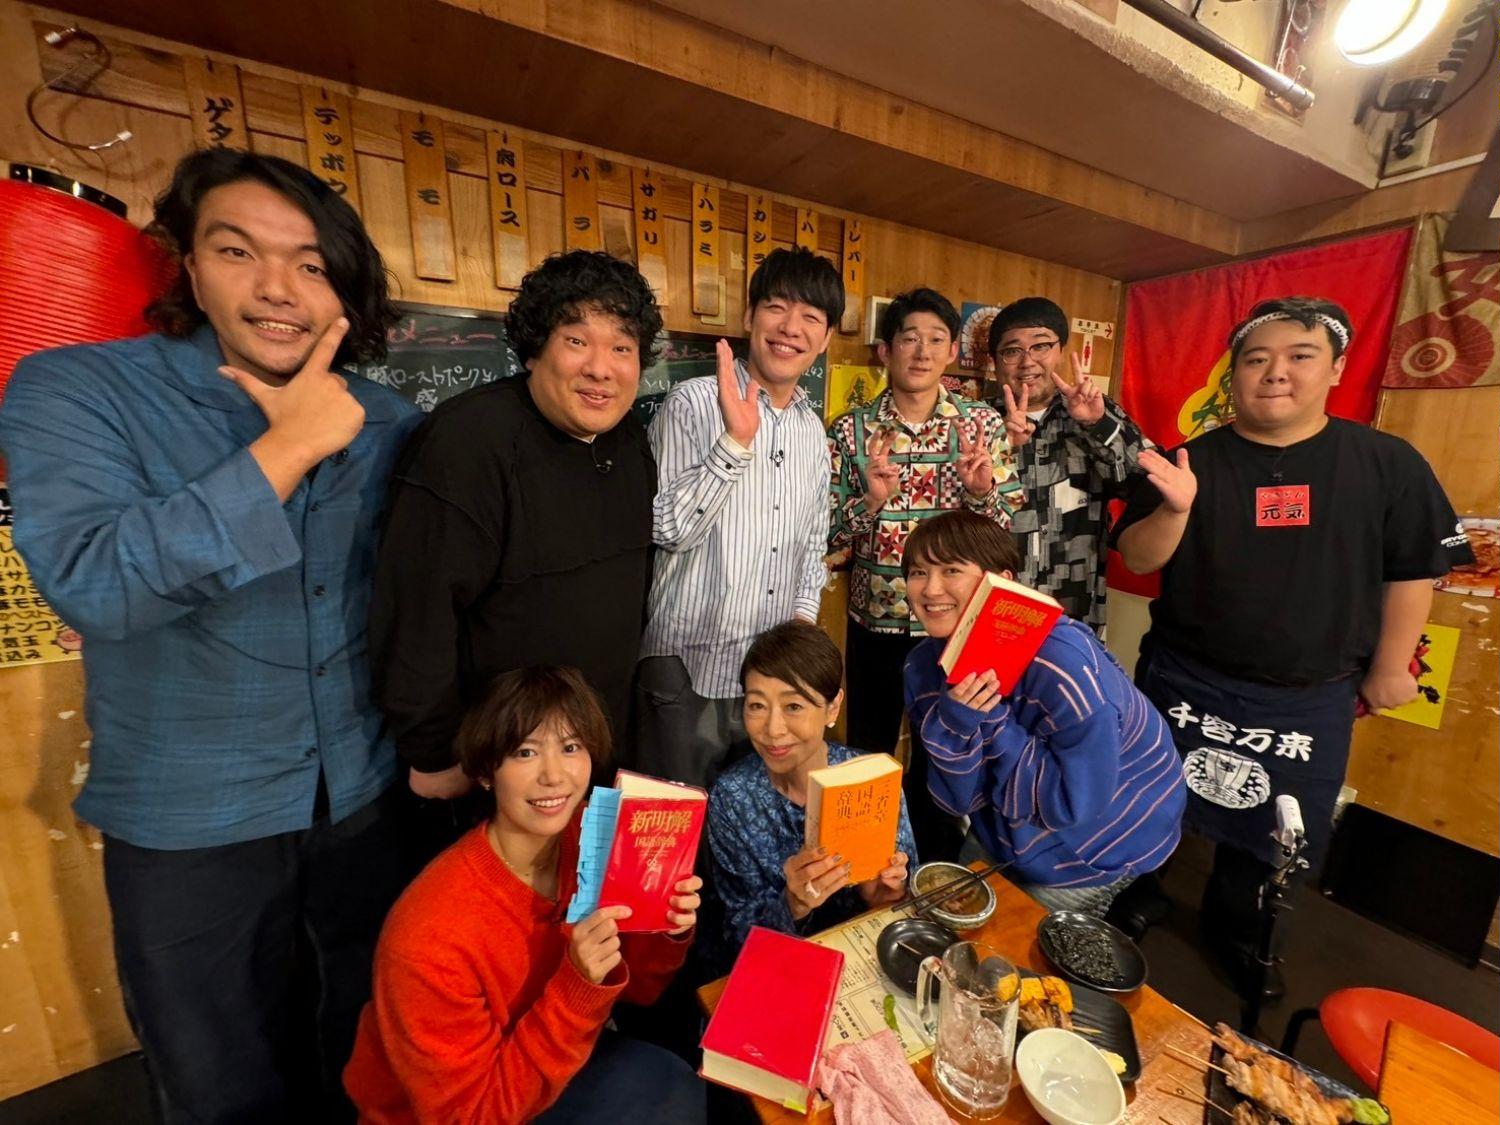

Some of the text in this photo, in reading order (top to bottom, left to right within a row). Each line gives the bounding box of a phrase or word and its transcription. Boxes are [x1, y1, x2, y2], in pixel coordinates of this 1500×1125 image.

[412, 129, 441, 205] モモ
[496, 148, 520, 228] 肩ロース
[571, 166, 592, 231] バラ
[639, 183, 657, 245] サガリ
[698, 198, 715, 257] ハラミ
[848, 233, 861, 282] レバー
[1261, 503, 1304, 520] 元気
[0, 649, 42, 662] 込み
[1168, 701, 1314, 762] 千客万来
[628, 809, 693, 834] 新明解
